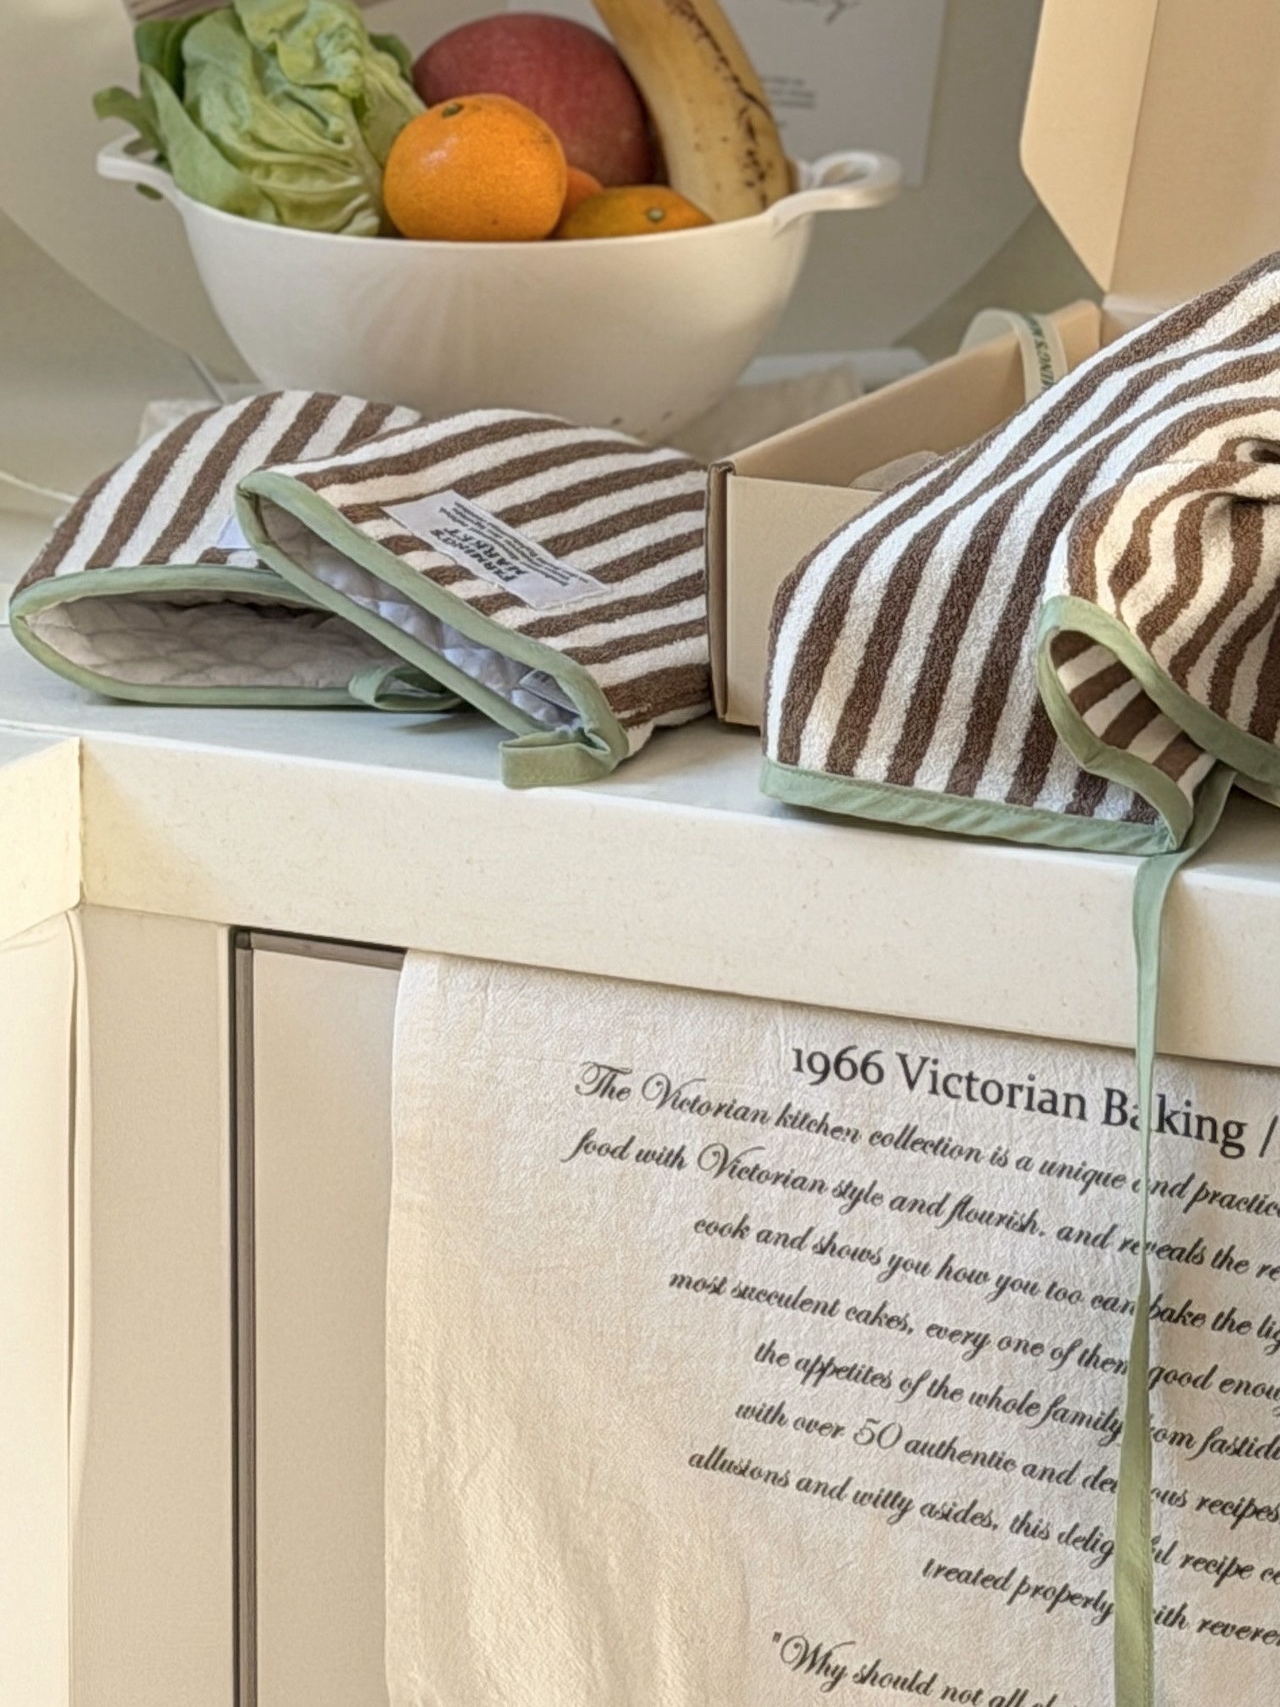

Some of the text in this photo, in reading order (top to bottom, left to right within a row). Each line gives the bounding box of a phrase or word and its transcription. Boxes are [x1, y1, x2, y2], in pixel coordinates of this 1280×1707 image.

[575, 1062, 632, 1100] The
[642, 1077, 769, 1124] Victorian
[774, 1102, 859, 1143] kitchen
[868, 1124, 980, 1163] collection
[989, 1147, 1008, 1168] is
[1015, 1156, 1032, 1171] a
[1038, 1160, 1127, 1196] unique
[791, 1045, 886, 1085] 1966
[894, 1052, 1087, 1122] Victorian
[1258, 1114, 1279, 1158] /
[561, 1130, 637, 1162] food
[636, 1145, 685, 1170] with
[697, 1144, 826, 1194] Victorian
[832, 1180, 884, 1213] style
[889, 1193, 948, 1226] and
[1056, 1223, 1118, 1251] and
[1210, 1244, 1250, 1275] the
[669, 1274, 727, 1295] most
[731, 1285, 840, 1317] succulent
[845, 1301, 914, 1335] cakes,
[926, 1323, 991, 1361] every
[997, 1336, 1045, 1357] one
[1050, 1338, 1085, 1371] of
[1147, 1364, 1219, 1391] good
[694, 1214, 750, 1239] cook
[756, 1226, 817, 1251] and
[814, 1233, 882, 1266] shows
[883, 1254, 930, 1282] you
[935, 1253, 989, 1285] how
[985, 1271, 1038, 1301] you
[1045, 1281, 1082, 1305] too
[1090, 1294, 1136, 1316] can
[1147, 1293, 1207, 1328] bake
[1210, 1306, 1253, 1336] the
[735, 1401, 787, 1426] with
[793, 1417, 845, 1438] over
[853, 1418, 904, 1447] 50
[904, 1436, 1016, 1471] authentic
[1021, 1459, 1083, 1486] and
[754, 1339, 790, 1365] the
[794, 1354, 892, 1389] appetites
[899, 1372, 930, 1401] of
[926, 1374, 964, 1401] the
[968, 1385, 1038, 1417] whole
[1033, 1395, 1124, 1447] family
[688, 1445, 789, 1487] allusions
[796, 1476, 853, 1501] and
[852, 1488, 913, 1524] witty
[1009, 1510, 1050, 1541] this
[1179, 1553, 1255, 1588] recipe
[922, 1558, 1017, 1593] treated
[1006, 1573, 1115, 1626] properly
[1152, 1602, 1188, 1630] ith
[853, 1658, 939, 1697] should
[940, 1686, 984, 1706] not
